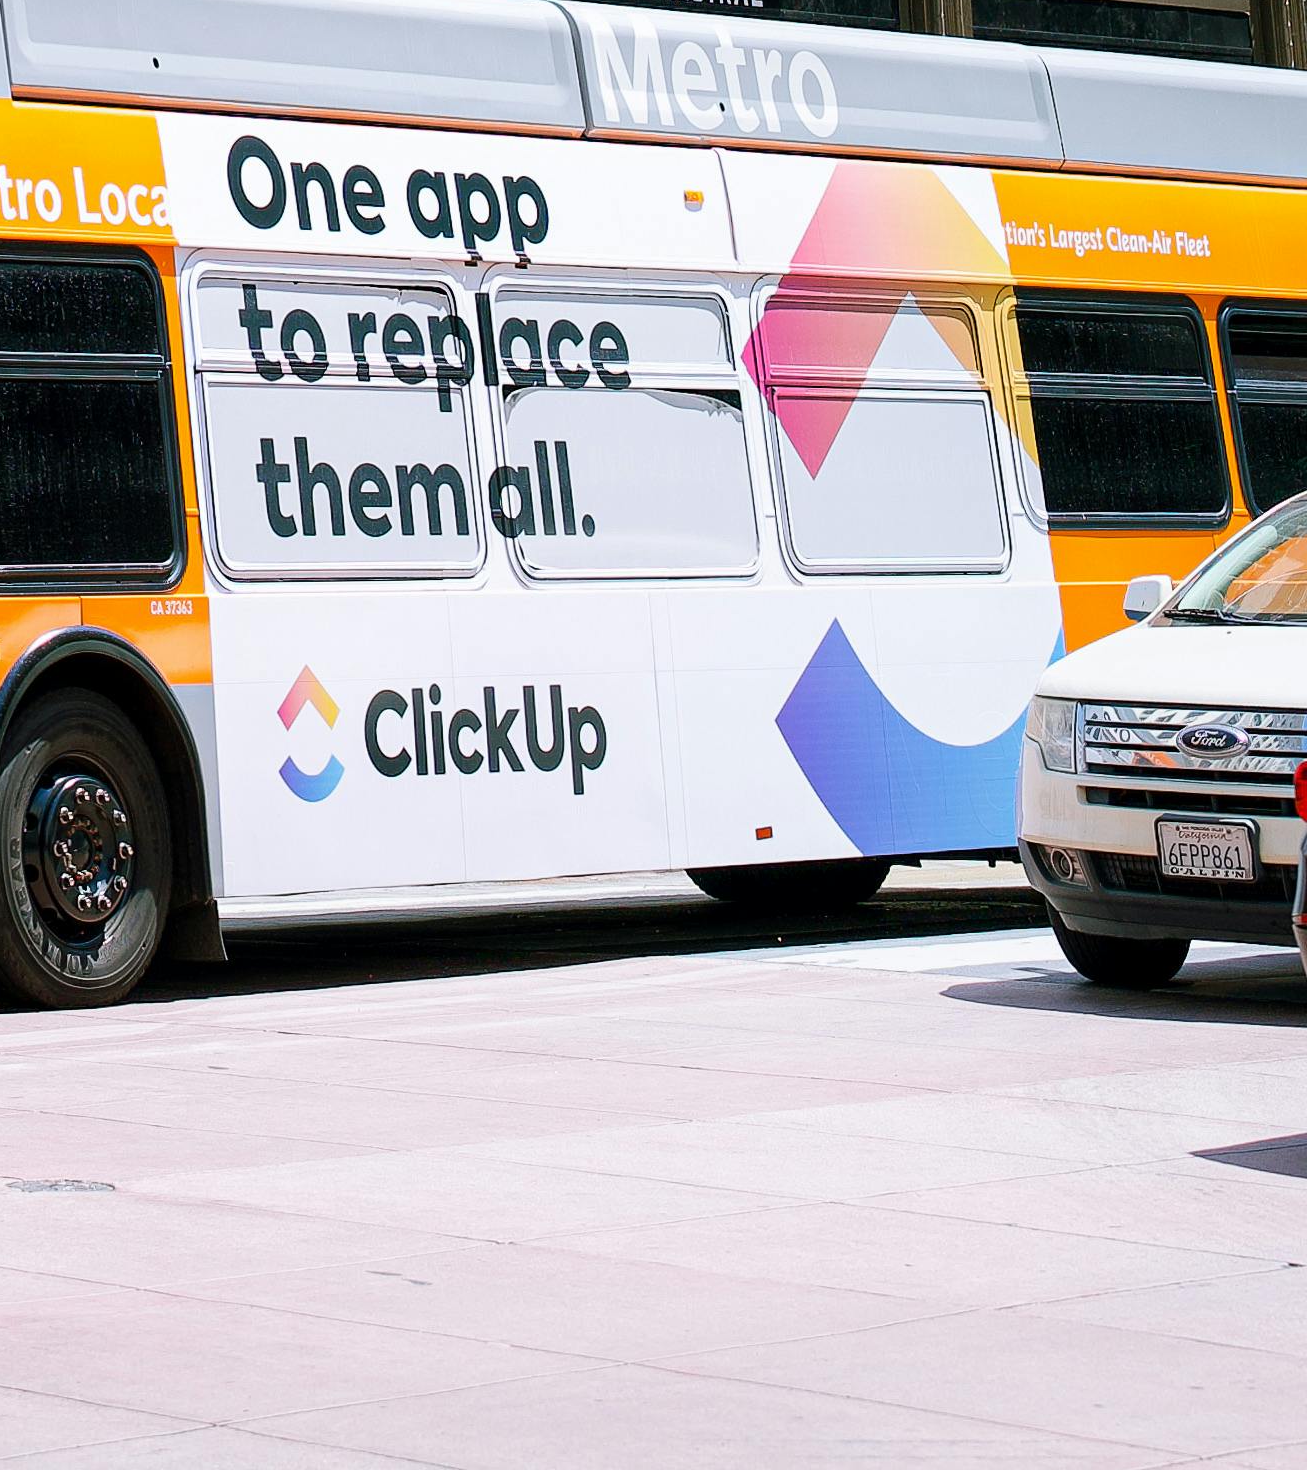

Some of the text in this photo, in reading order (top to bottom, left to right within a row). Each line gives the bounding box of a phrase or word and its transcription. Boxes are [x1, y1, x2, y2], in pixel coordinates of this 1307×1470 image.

[590, 8, 840, 140] Metro
[227, 135, 550, 265] One app
[1003, 220, 1211, 258] tion's Largest Clean-Air Fleet
[239, 283, 631, 413] to replace
[255, 436, 597, 538] them all.
[150, 600, 165, 615] CA
[365, 683, 607, 795] ClickUp
[1190, 728, 1228, 748] Ford
[1169, 842, 1246, 871] 6FPP861
